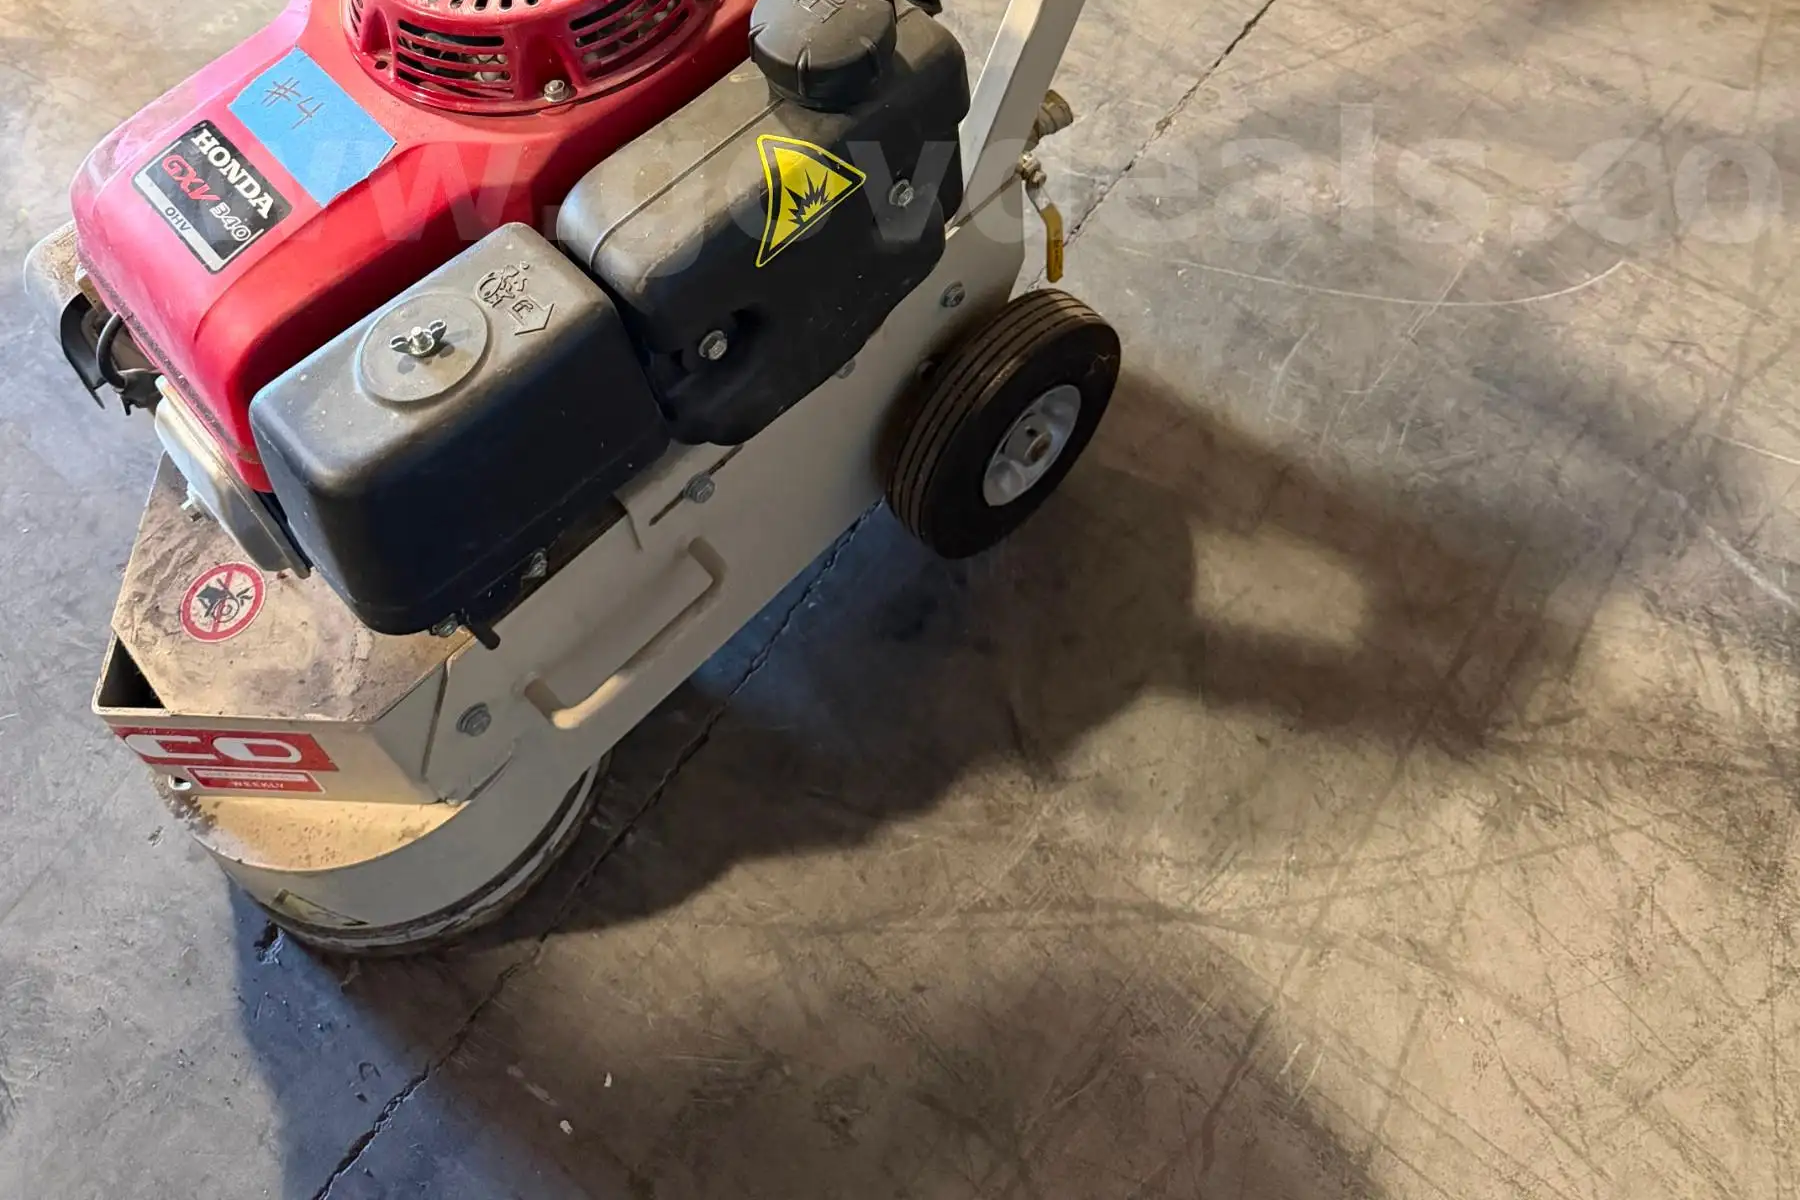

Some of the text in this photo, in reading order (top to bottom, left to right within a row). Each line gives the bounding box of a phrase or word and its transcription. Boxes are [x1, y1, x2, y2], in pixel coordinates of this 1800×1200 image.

[261, 76, 324, 130] #4
[161, 155, 251, 242] GXV 340
[190, 129, 275, 219] HONDA
[164, 207, 192, 232] OHV
